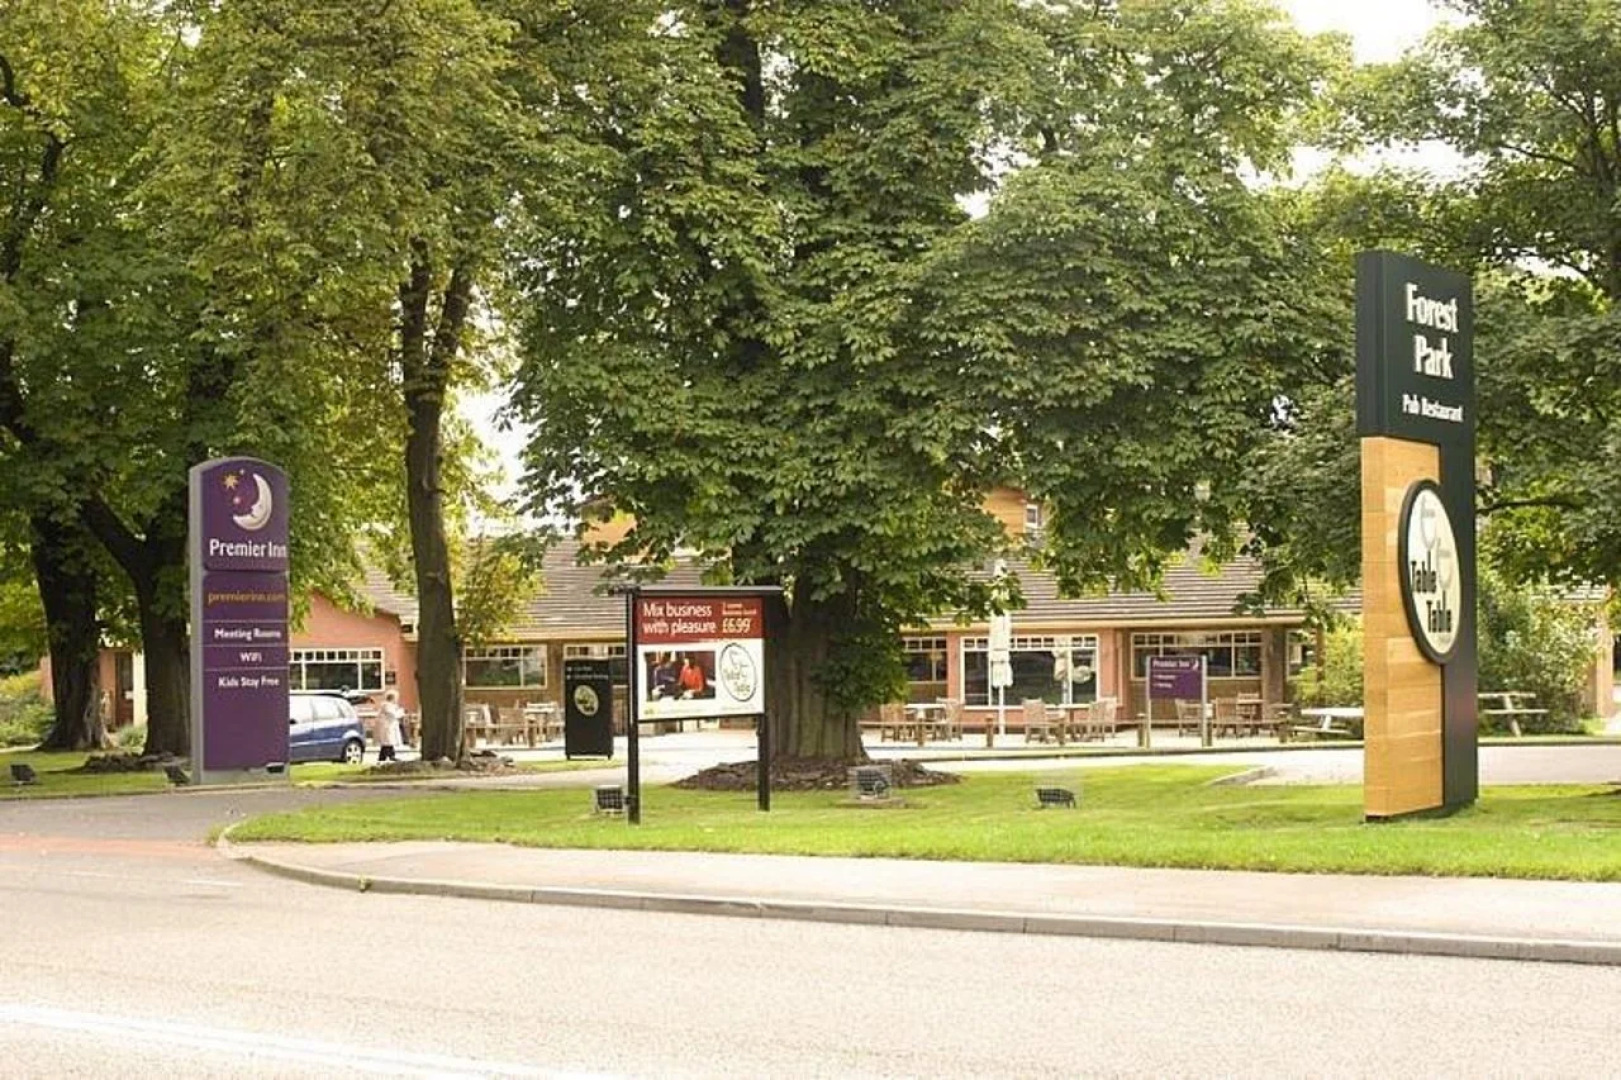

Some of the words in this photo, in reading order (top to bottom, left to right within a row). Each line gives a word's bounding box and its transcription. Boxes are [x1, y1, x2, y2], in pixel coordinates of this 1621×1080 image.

[1406, 282, 1459, 333] Forest
[1414, 334, 1454, 379] Park
[209, 538, 267, 557] Premier
[268, 540, 287, 558] Inn
[1411, 551, 1437, 594] Table
[643, 602, 664, 617] Mix
[666, 601, 712, 618] business
[1426, 591, 1452, 633] Table
[214, 627, 252, 641] Meeting
[642, 618, 669, 634] with
[671, 618, 717, 637] pleasure
[218, 676, 239, 688] Kids
[240, 676, 260, 689] Stay
[261, 675, 280, 687] Free
